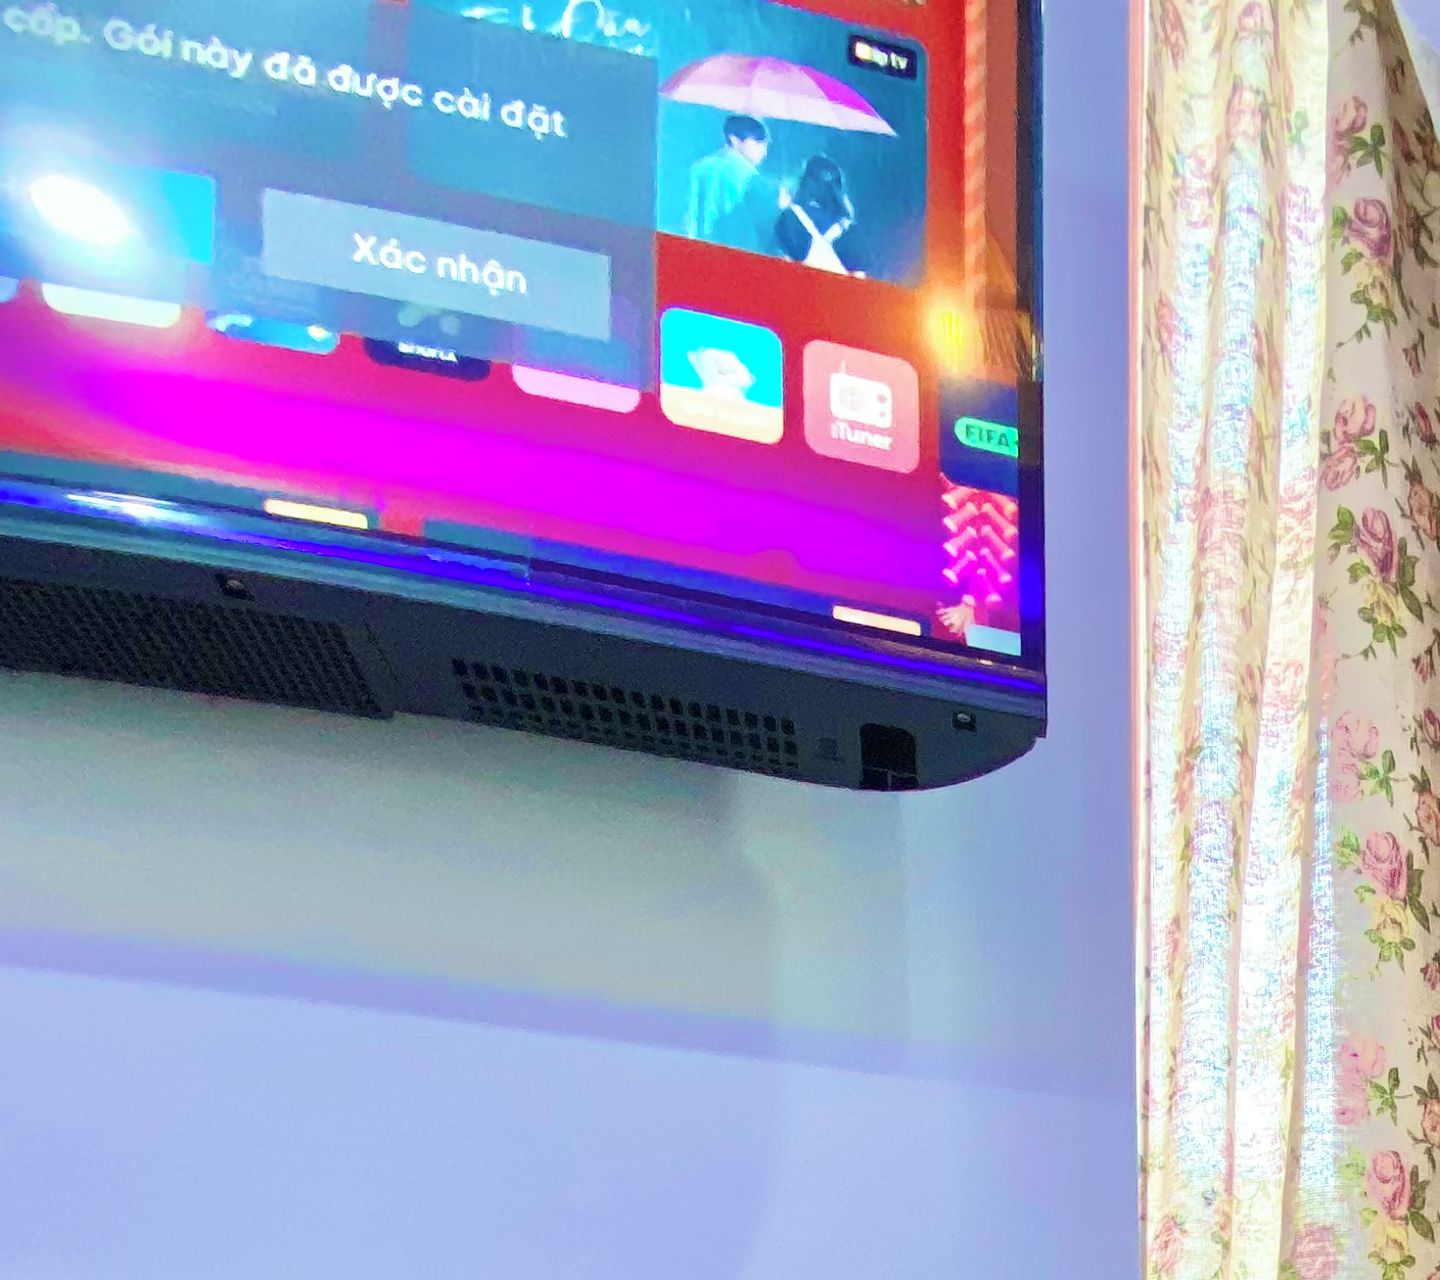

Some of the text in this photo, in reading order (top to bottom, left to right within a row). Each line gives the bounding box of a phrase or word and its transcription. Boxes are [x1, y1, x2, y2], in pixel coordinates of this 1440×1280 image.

[103, 16, 174, 58] Gói
[179, 35, 253, 79] này
[263, 50, 317, 87] đã
[327, 63, 424, 111] được
[500, 99, 568, 141] đặt
[352, 232, 528, 296] Xác nhận
